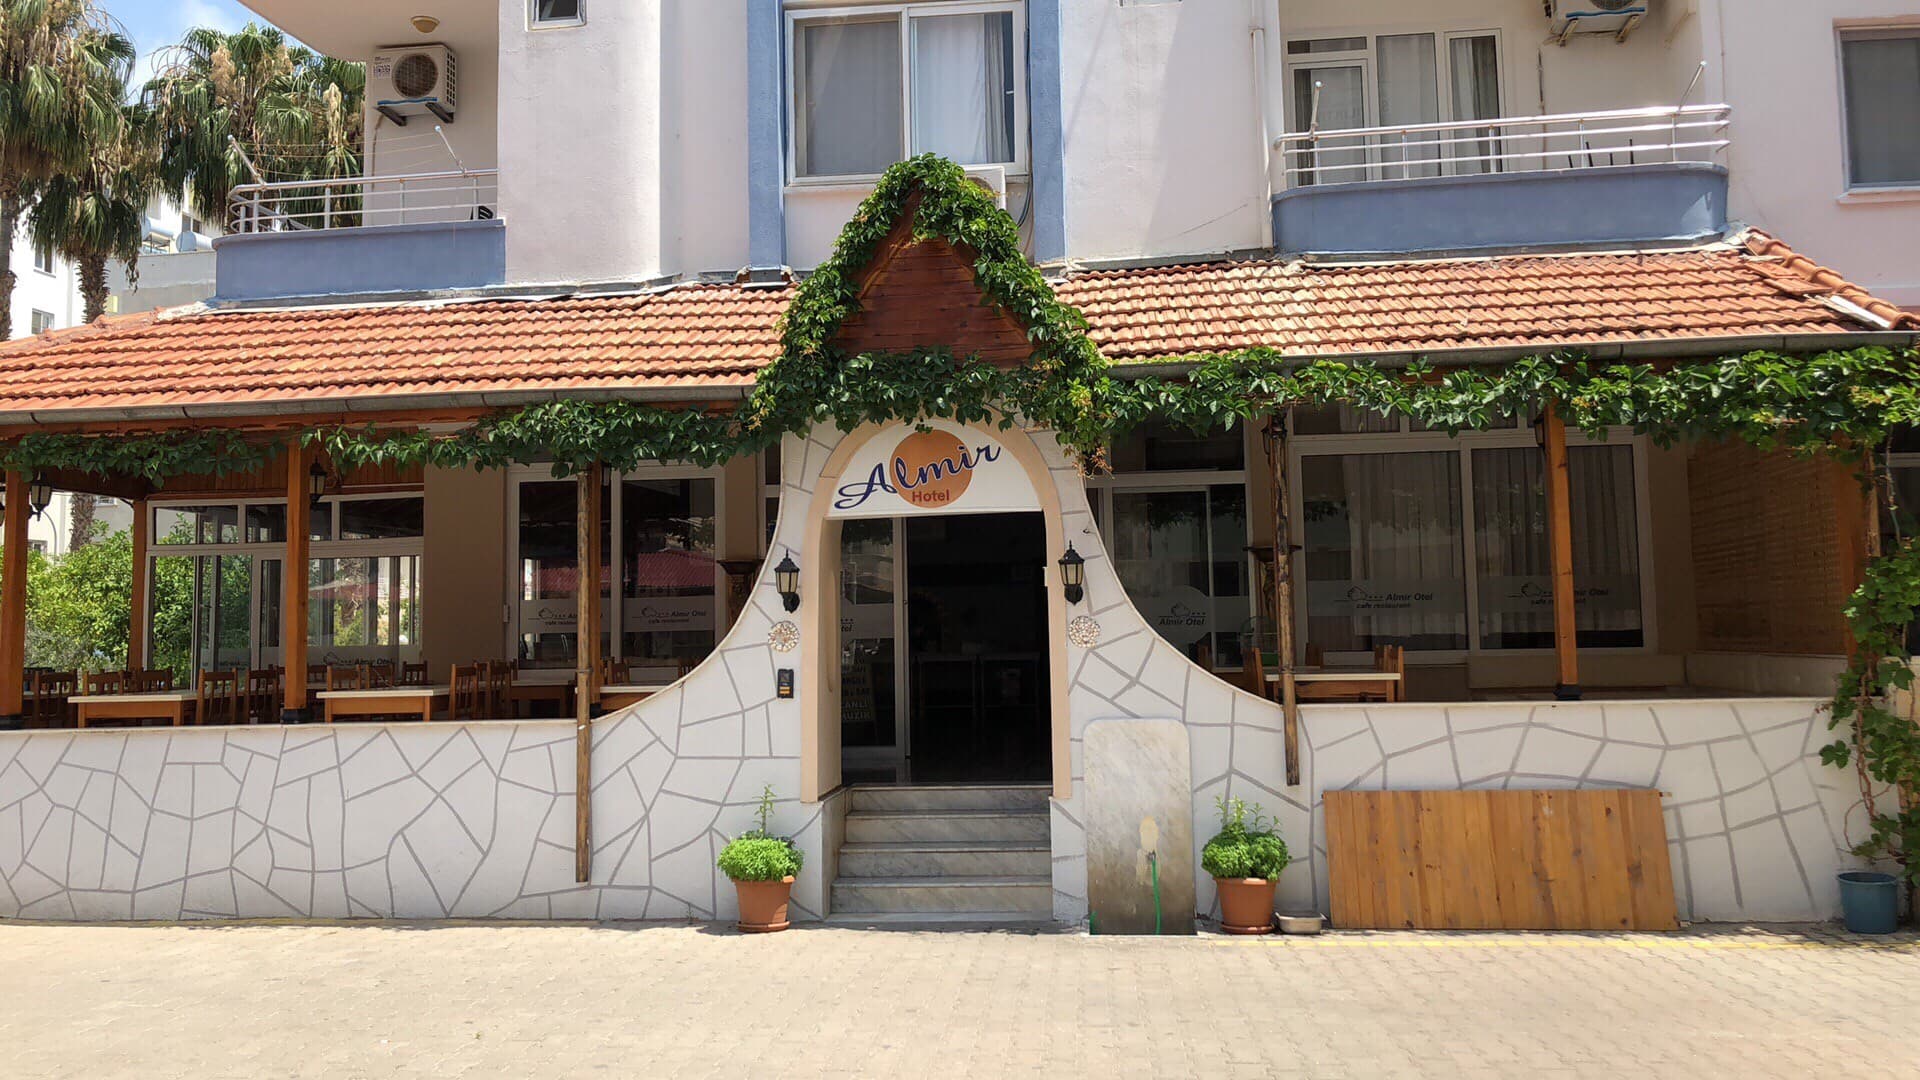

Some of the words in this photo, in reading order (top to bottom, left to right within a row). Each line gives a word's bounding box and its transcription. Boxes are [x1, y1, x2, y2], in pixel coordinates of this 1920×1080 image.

[834, 445, 1001, 509] Almir
[912, 489, 950, 503] Hotel
[1386, 592, 1411, 601] Almir
[1414, 592, 1433, 601] Otel
[1186, 617, 1205, 625] Otel
